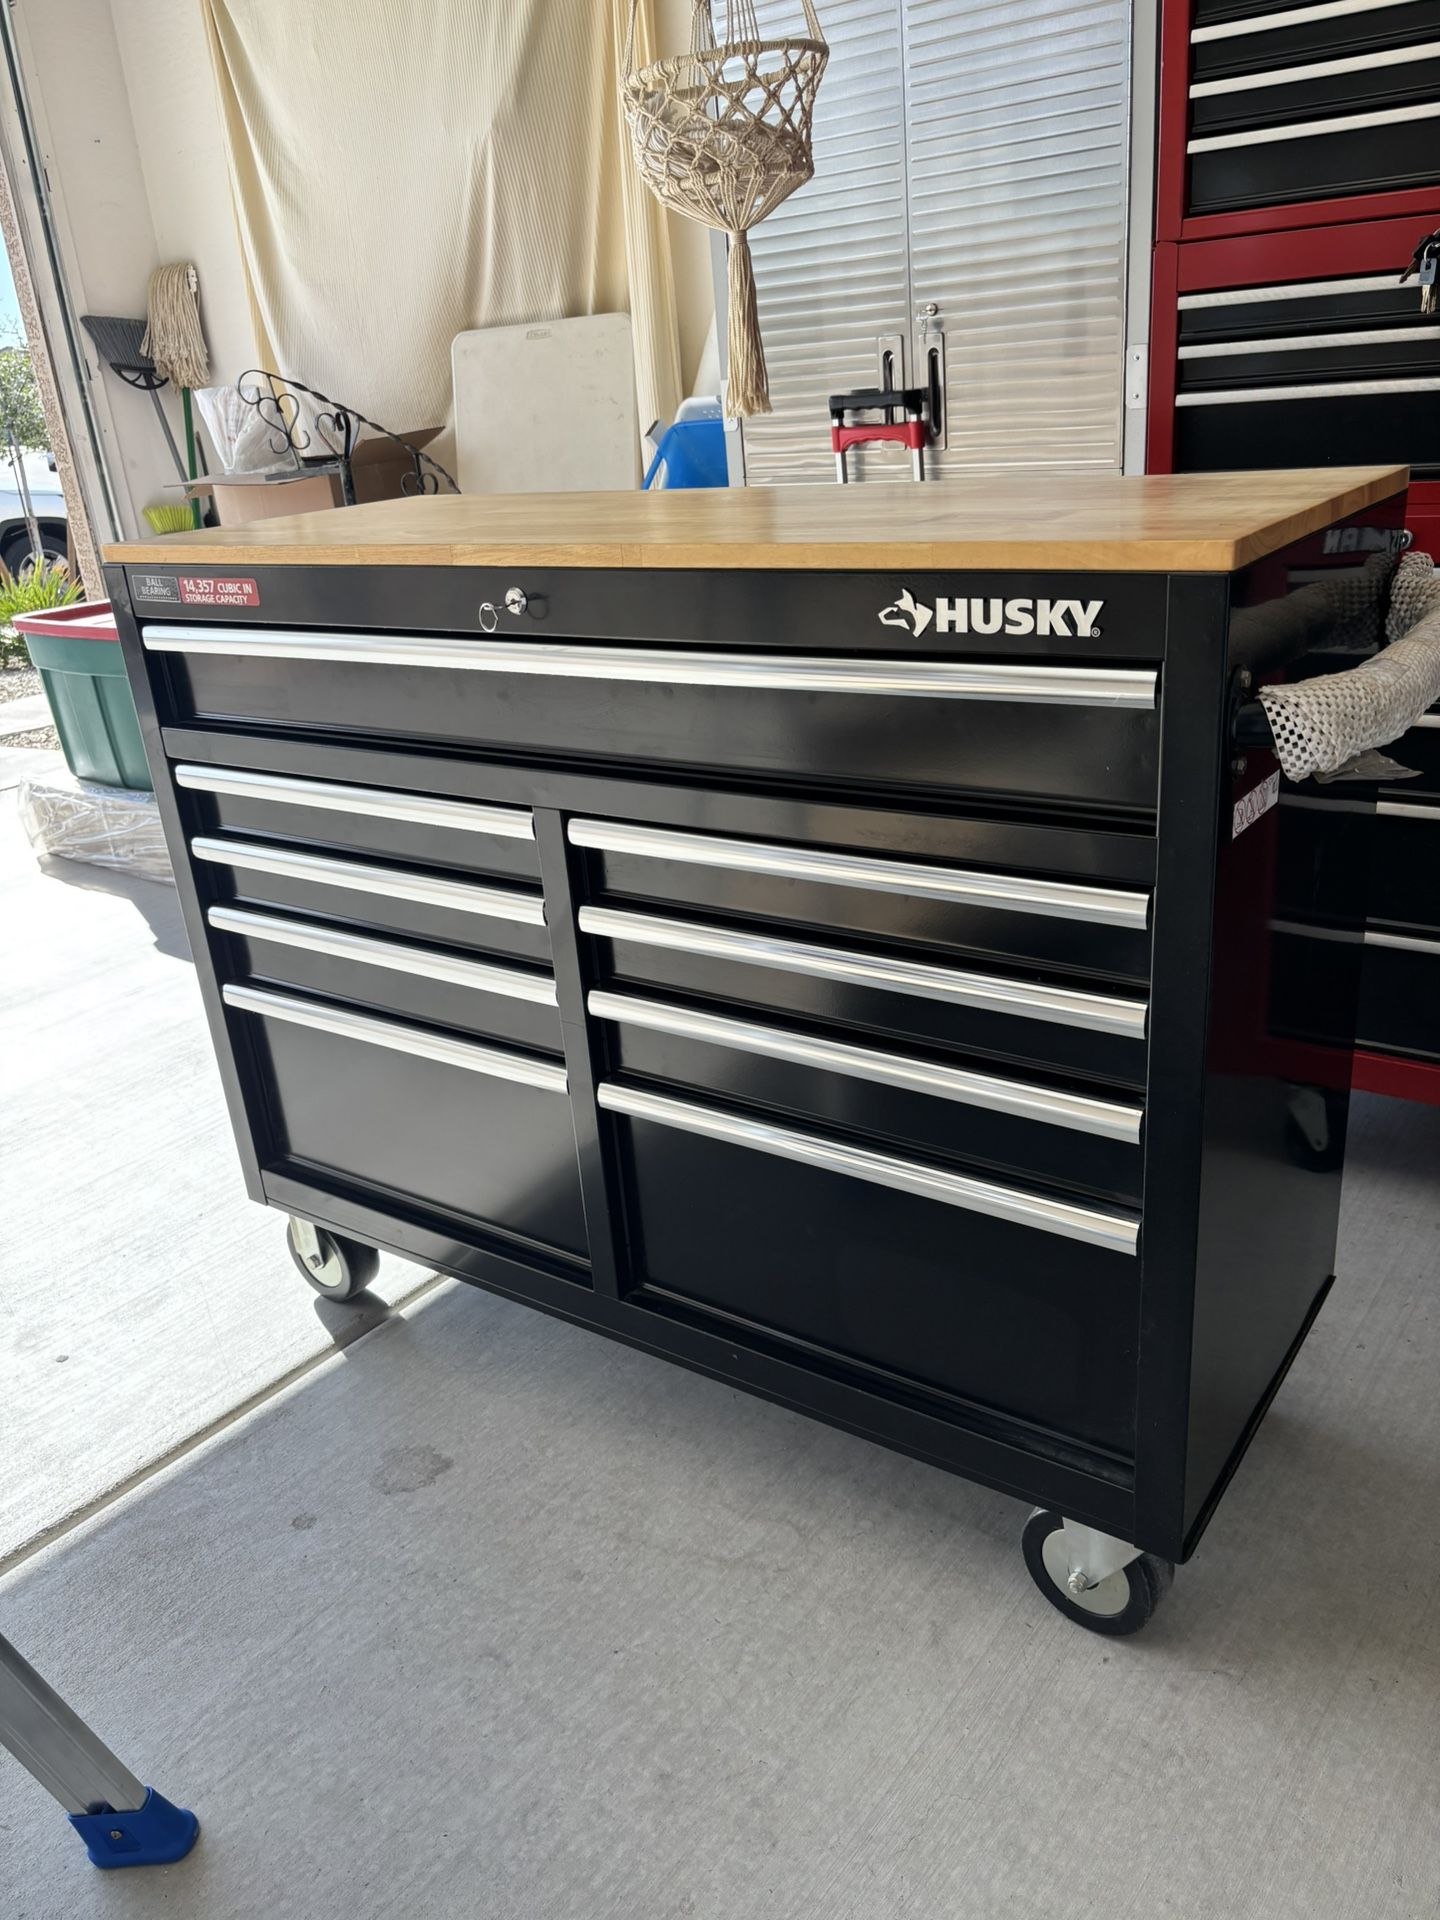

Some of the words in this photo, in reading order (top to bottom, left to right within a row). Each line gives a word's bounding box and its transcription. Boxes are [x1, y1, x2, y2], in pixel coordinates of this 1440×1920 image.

[146, 578, 163, 587] BALL
[183, 580, 214, 594] 14,357
[217, 583, 242, 593] CUBIC
[243, 584, 252, 594] IN
[141, 586, 172, 596] BEARING
[185, 594, 216, 603] STORAGE
[215, 594, 248, 605] CAPACITY
[936, 597, 1104, 637] HUSKY
